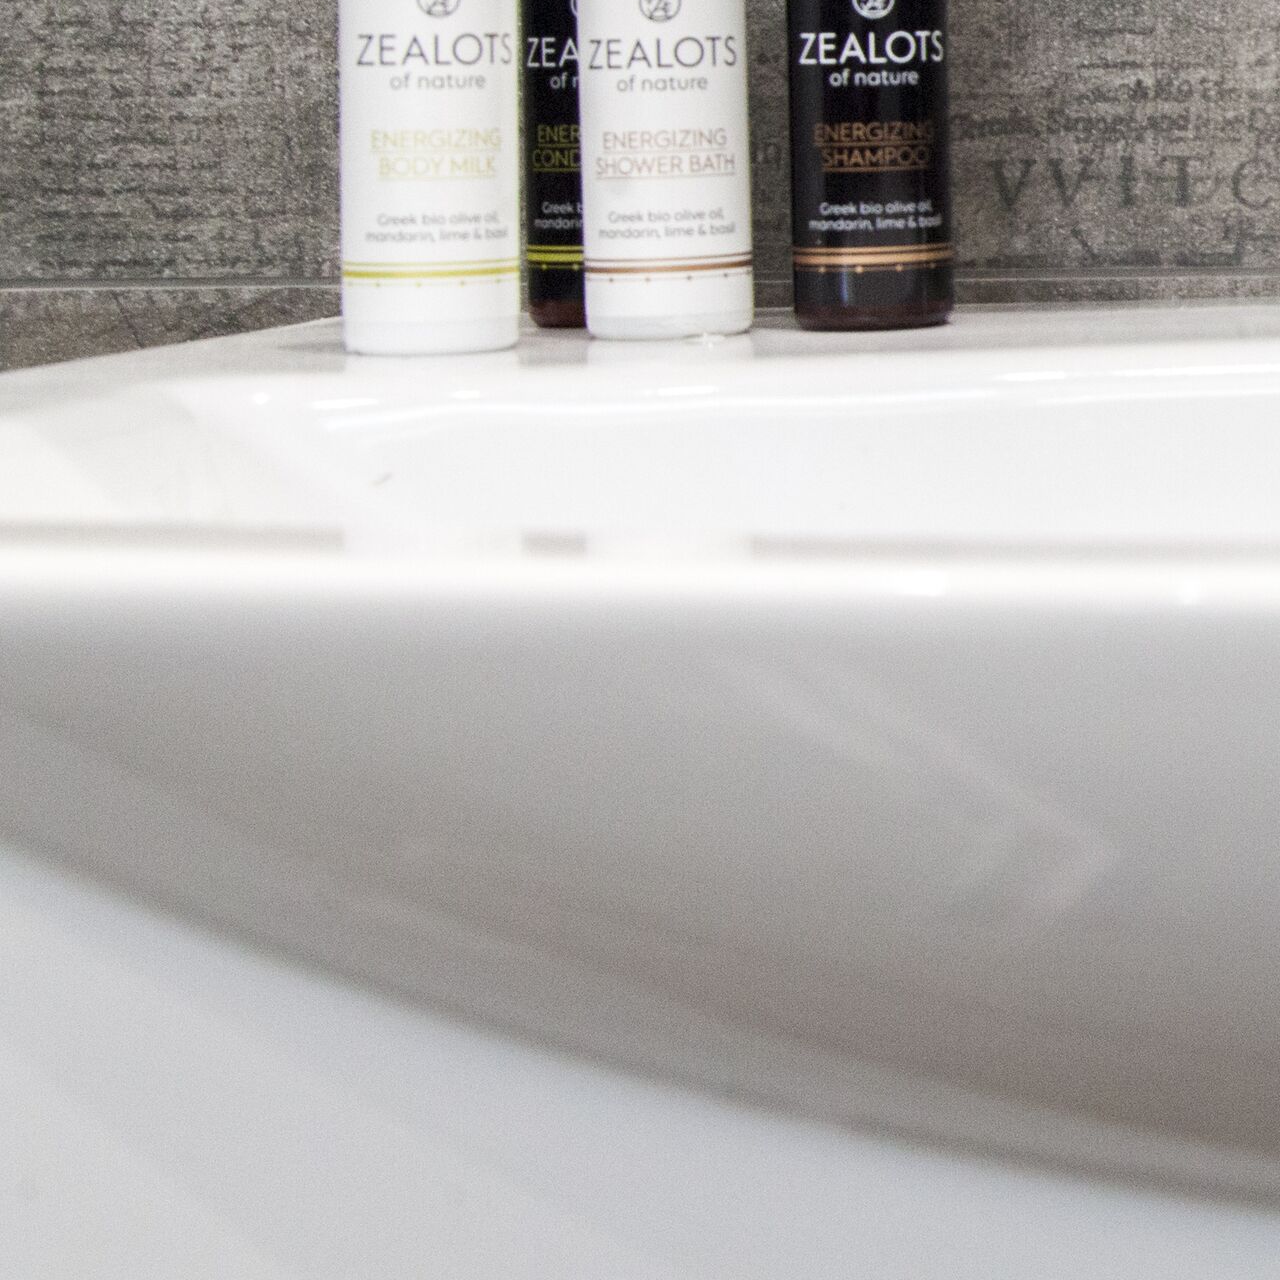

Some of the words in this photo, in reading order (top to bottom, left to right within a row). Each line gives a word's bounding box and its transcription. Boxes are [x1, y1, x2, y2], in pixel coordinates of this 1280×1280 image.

[356, 32, 513, 67] ZEALOTS
[526, 36, 579, 68] ZEA
[588, 35, 738, 70] ZEALOTS
[798, 29, 945, 65] ZEALOTS
[389, 72, 411, 91] of
[417, 73, 487, 90] nature
[549, 71, 569, 90] of
[616, 73, 635, 93] of
[641, 75, 709, 92] nature
[828, 68, 851, 87] of
[854, 69, 920, 87] nature
[369, 127, 502, 150] ENERGIZING
[537, 123, 581, 142] ENER
[602, 127, 728, 151] ENERGIZING
[813, 121, 934, 145] ENERGIZING
[378, 155, 443, 177] BODY
[450, 155, 497, 175] MILK
[595, 155, 684, 176] SHOWER
[689, 153, 737, 174] BATH
[820, 146, 930, 167] SHAMPOO
